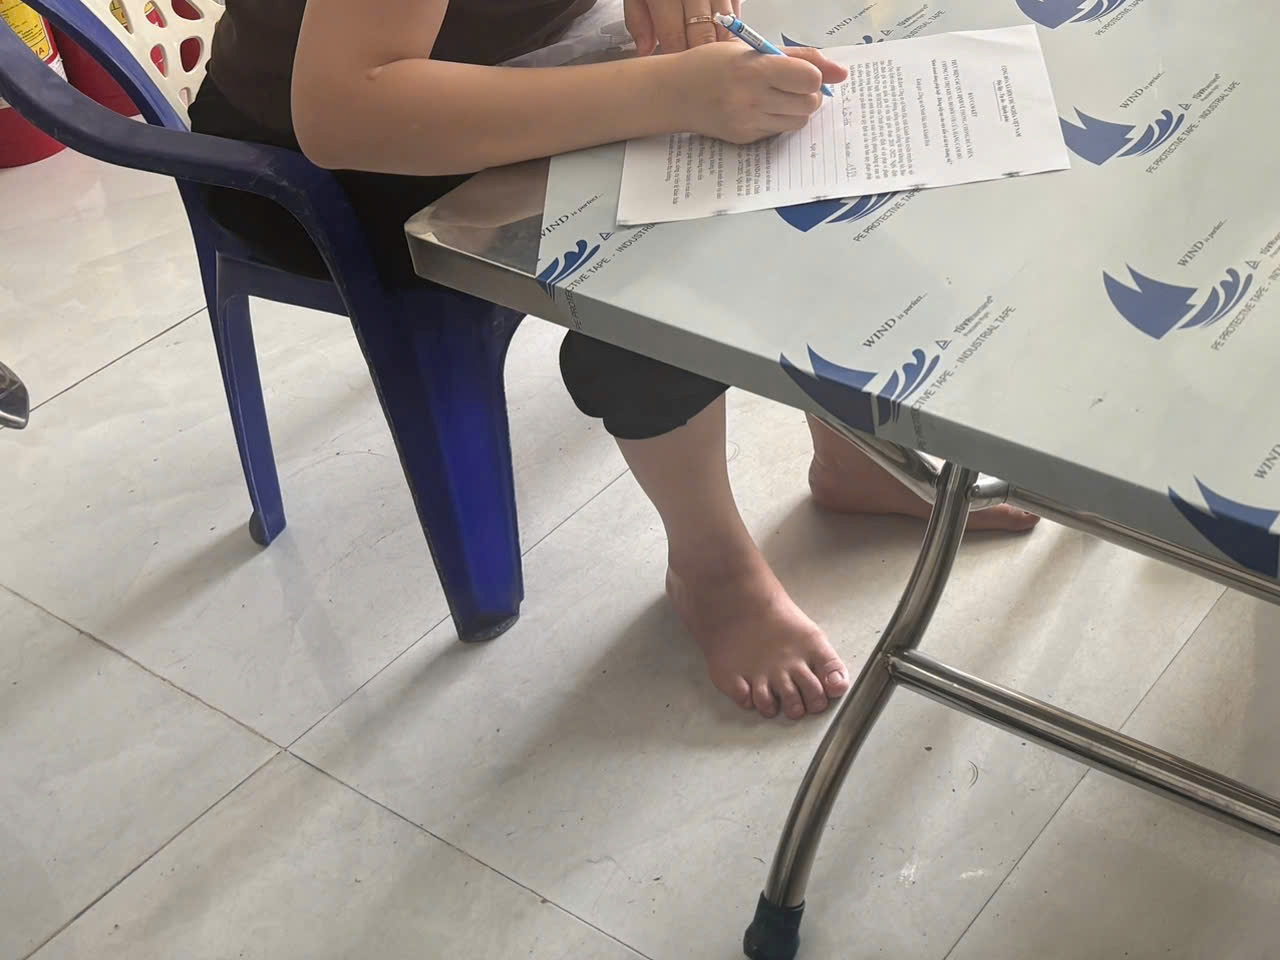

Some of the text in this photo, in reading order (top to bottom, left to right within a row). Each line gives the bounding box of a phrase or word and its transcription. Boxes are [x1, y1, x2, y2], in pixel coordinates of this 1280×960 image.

[825, 17, 853, 36] WIND
[927, 10, 945, 23] TAPE
[1119, 88, 1144, 109] WIND
[1145, 80, 1241, 174] PE PROTECTIVE TAPE INDUSTRIAL TAPE
[853, 232, 867, 242] PE
[863, 201, 904, 237] PROTECTIVE
[589, 257, 611, 276] TAPE
[1177, 240, 1205, 267] WIND
[1211, 339, 1225, 351] PE
[1219, 302, 1256, 343] PROTECTIVE
[1249, 284, 1269, 308] TAPE
[862, 318, 897, 348] WIND
[931, 305, 1016, 391] TAPE INDUSTRIAL TAPE
